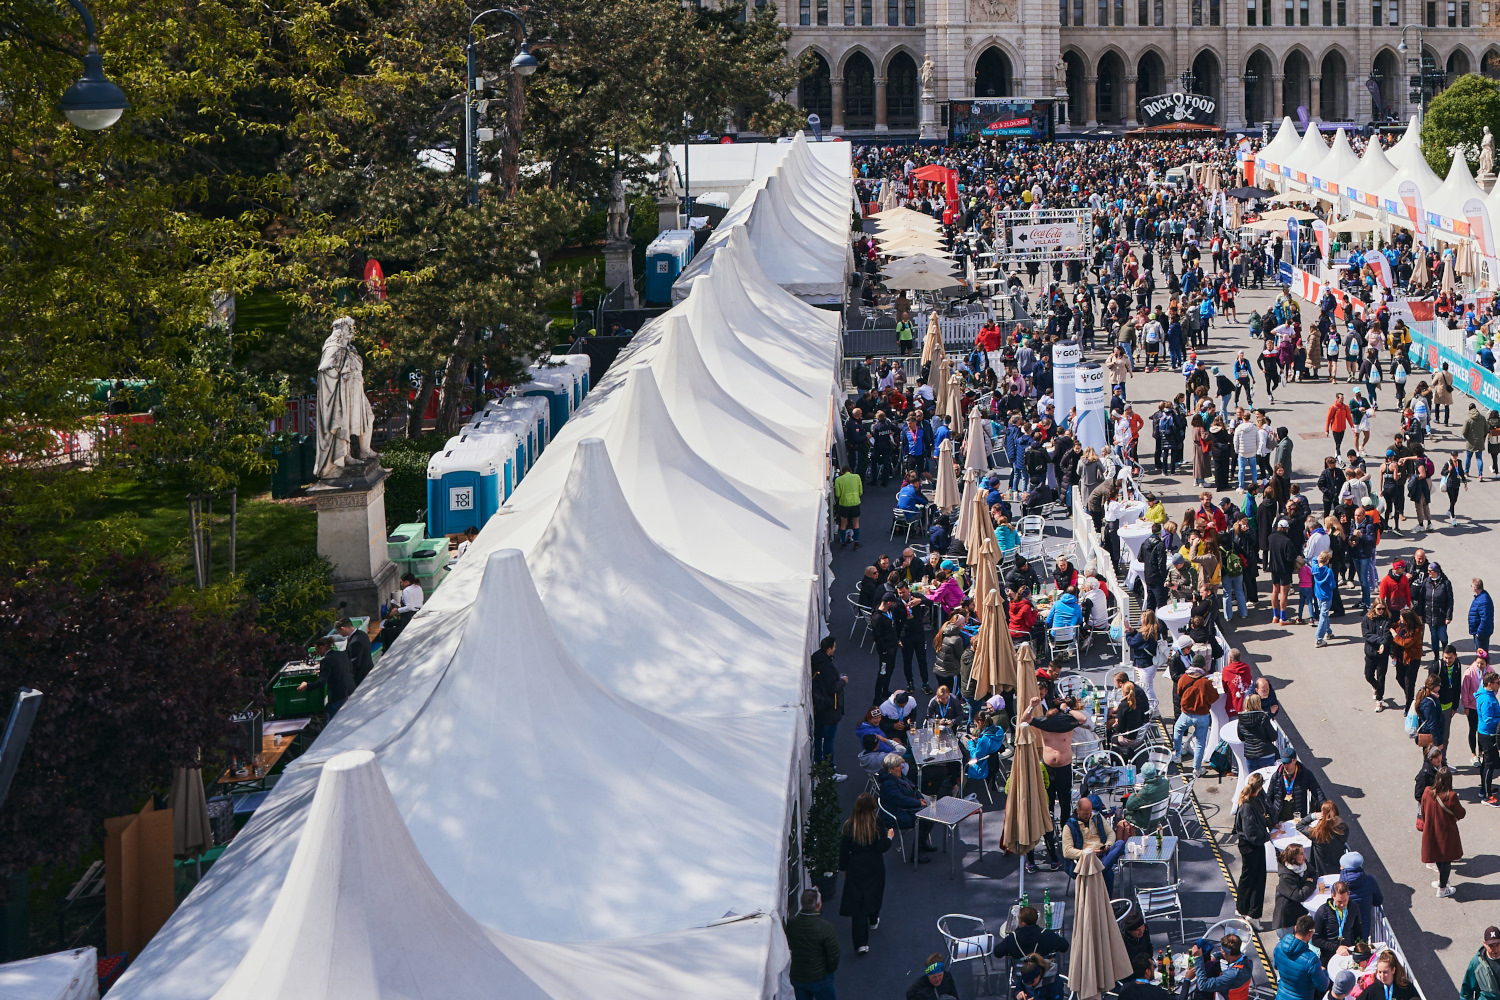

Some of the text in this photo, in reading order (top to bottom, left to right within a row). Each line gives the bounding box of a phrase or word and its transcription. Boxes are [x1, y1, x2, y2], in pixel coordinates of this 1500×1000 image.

[1144, 95, 1216, 117] ROCK FOOD
[455, 492, 470, 500] TOI
